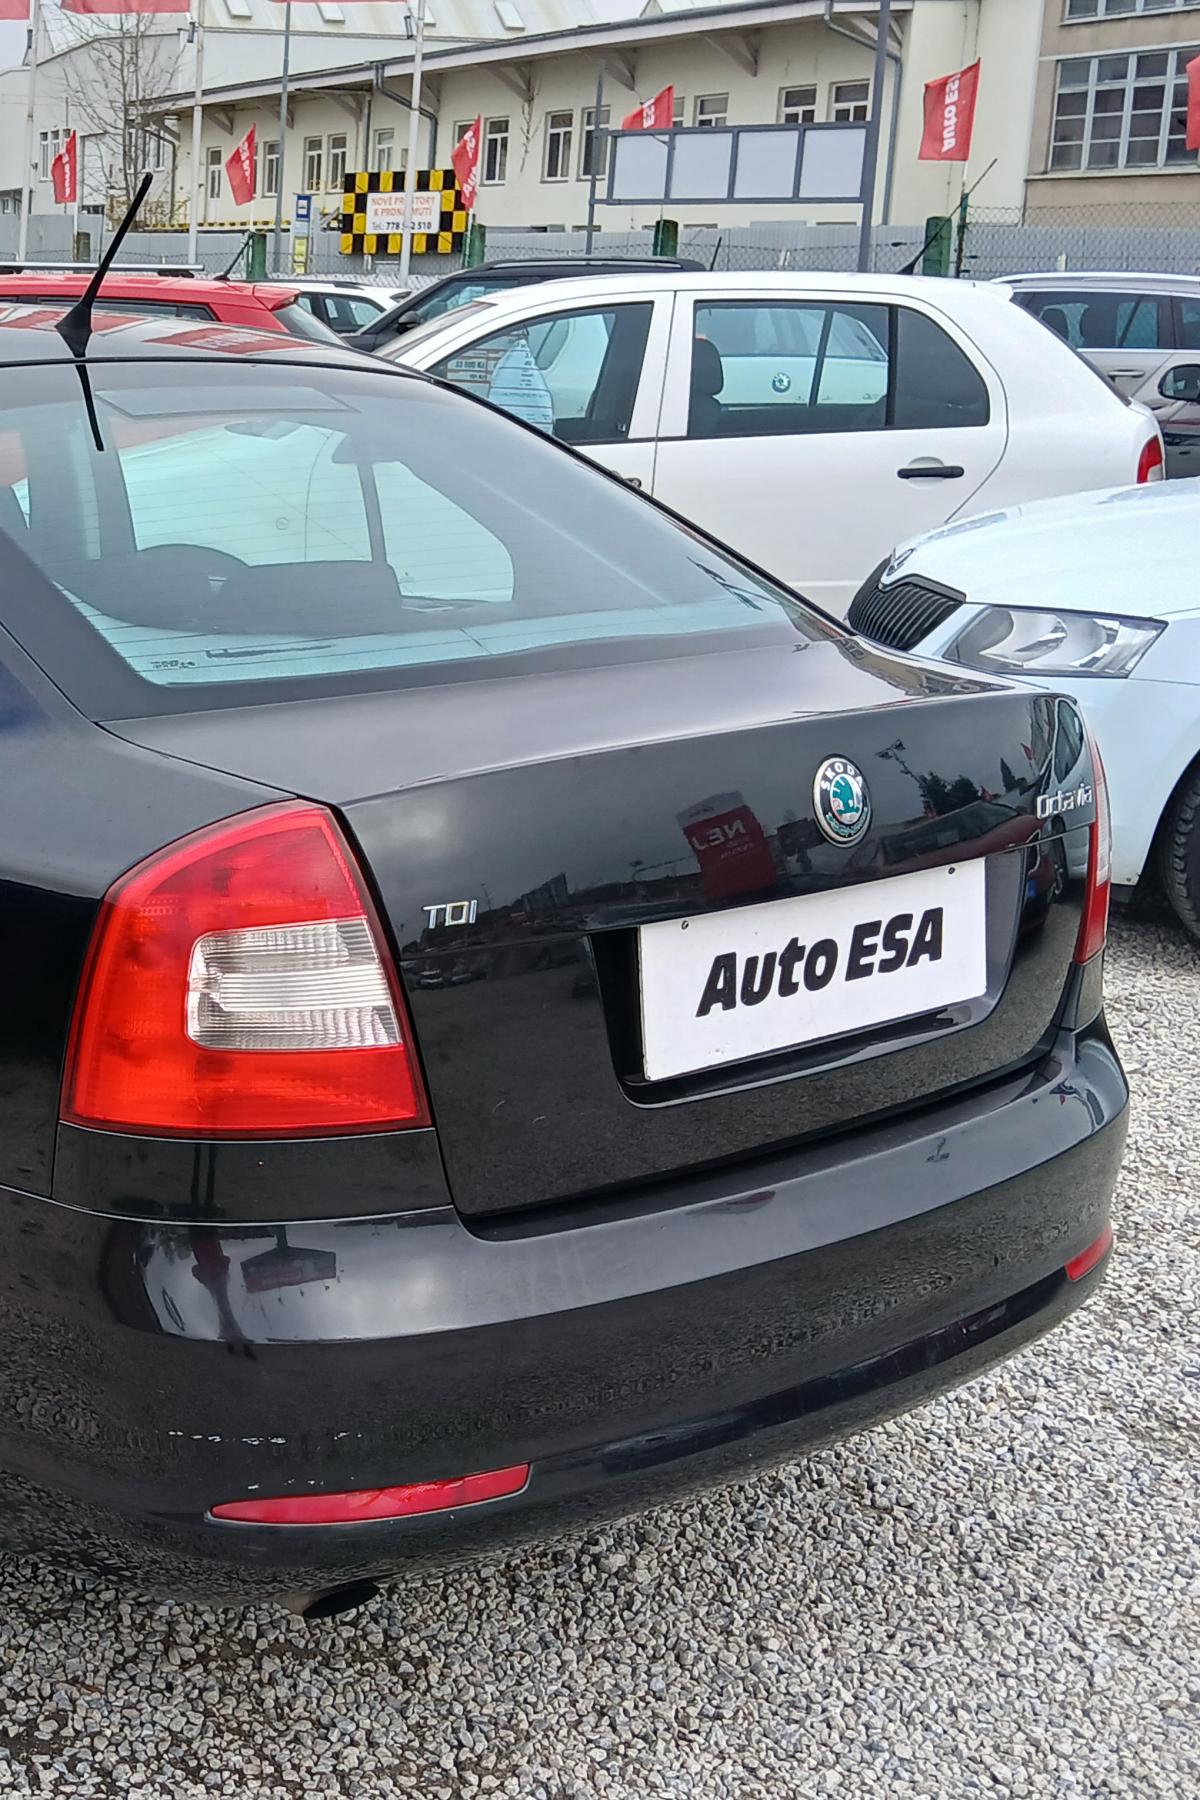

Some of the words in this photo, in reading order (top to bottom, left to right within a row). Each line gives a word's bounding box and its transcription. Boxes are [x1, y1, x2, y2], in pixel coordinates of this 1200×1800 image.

[423, 900, 477, 929] TDI
[695, 937, 838, 1018] Auto
[845, 907, 944, 982] ESA
